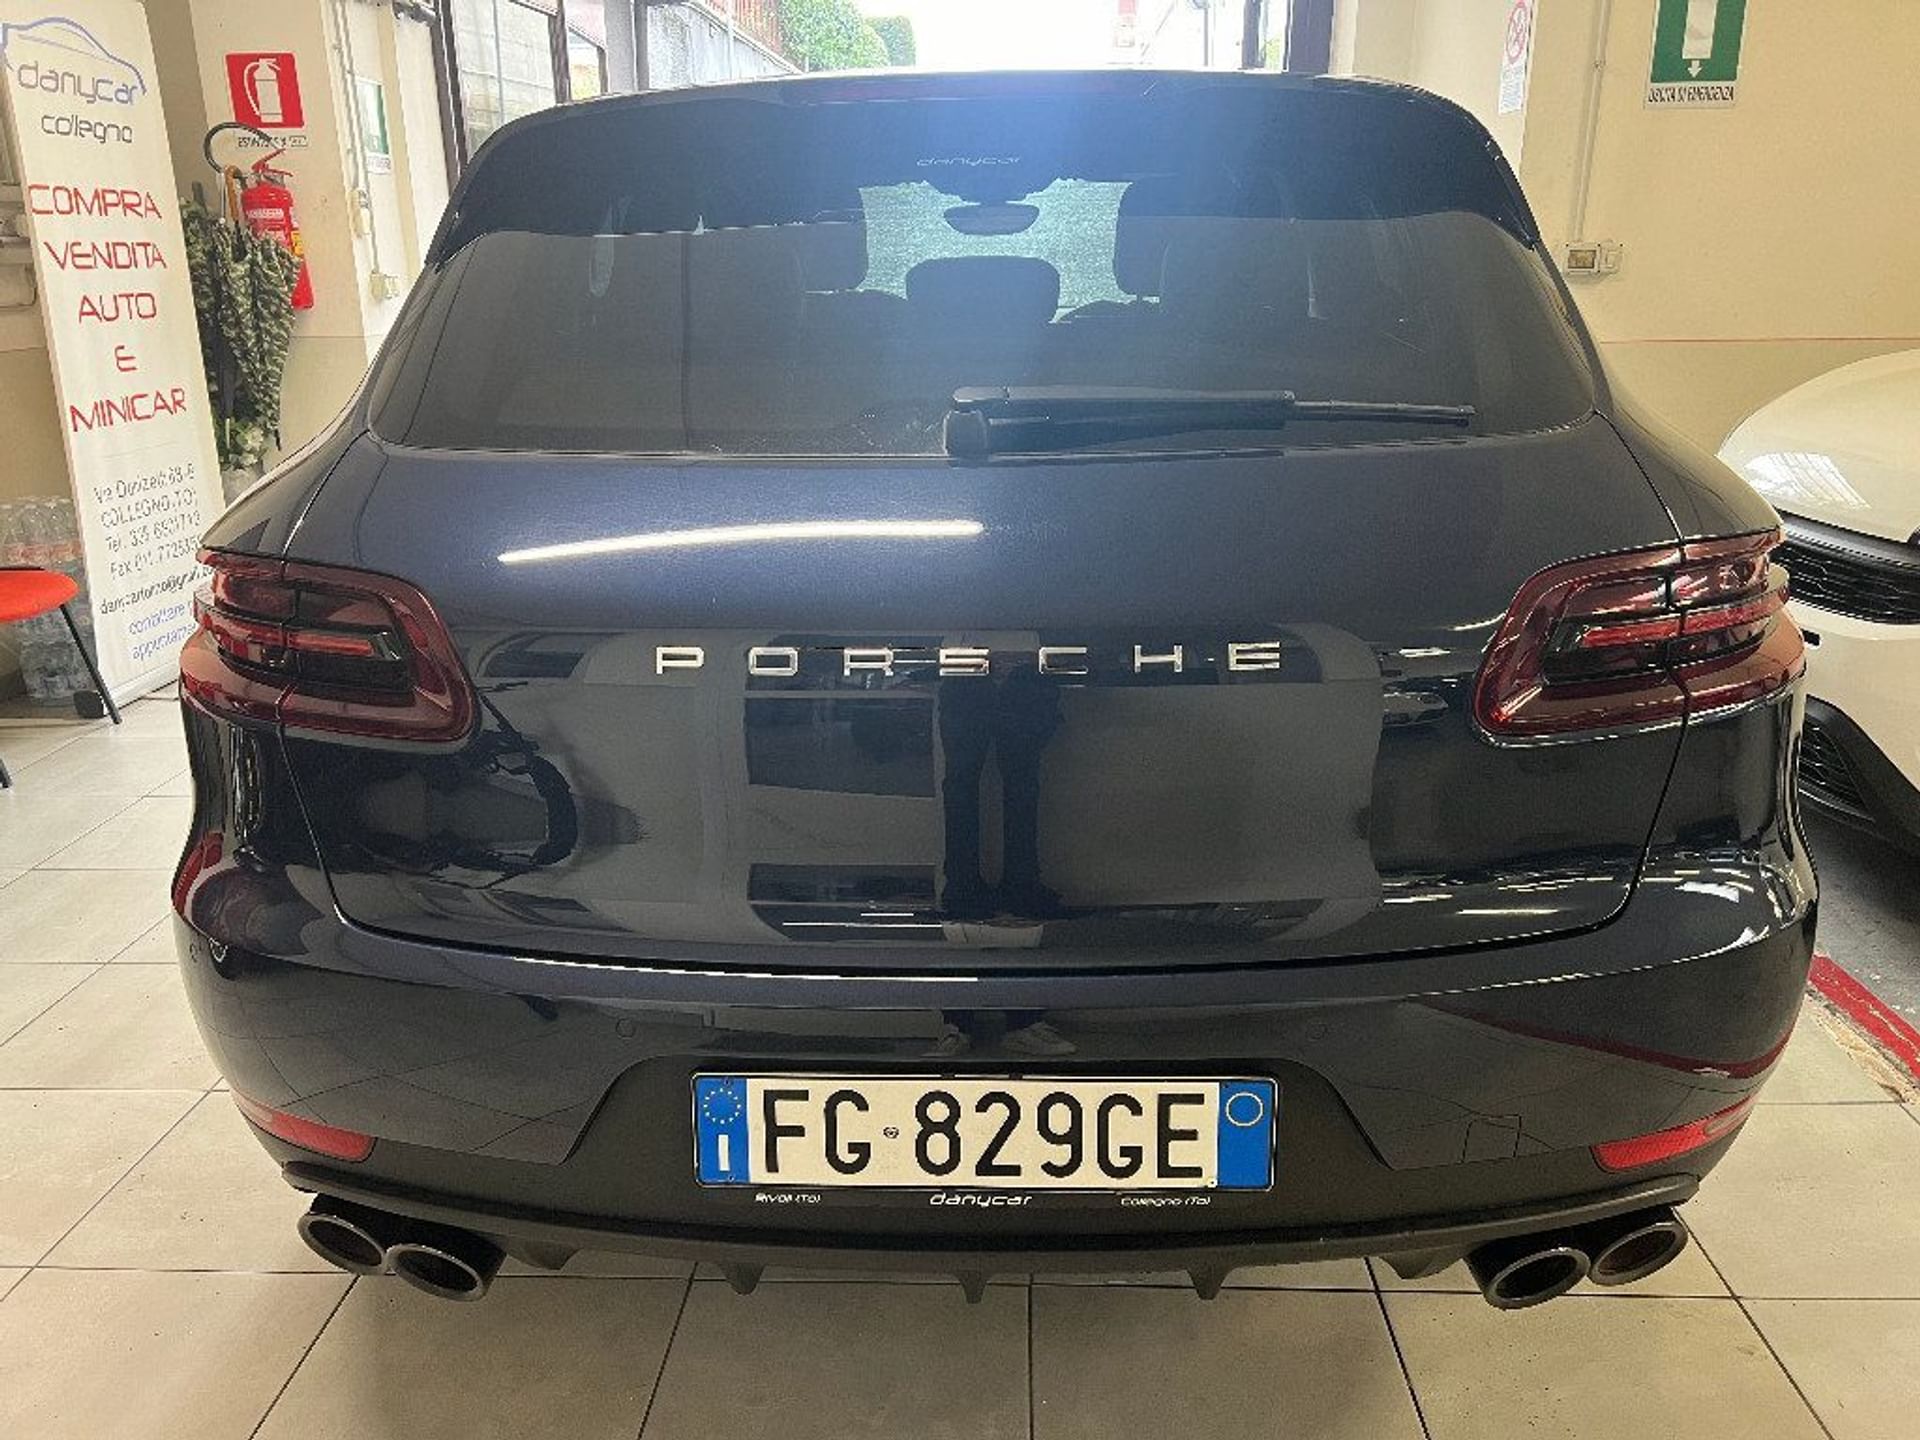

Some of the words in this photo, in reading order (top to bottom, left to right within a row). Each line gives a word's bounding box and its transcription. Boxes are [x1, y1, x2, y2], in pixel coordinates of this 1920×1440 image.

[17, 61, 138, 104] danycar
[41, 114, 133, 144] collegno
[916, 156, 1021, 167] danycar
[27, 184, 163, 219] COMPRA
[43, 241, 168, 270] VENDITA
[78, 292, 158, 323] AUTO
[114, 345, 137, 372] E
[69, 387, 188, 432] MINICAR
[656, 641, 1281, 676] PORSCHE
[762, 1089, 872, 1176] FG
[914, 1091, 1206, 1180] 829GE
[929, 1192, 1033, 1208] danycar
